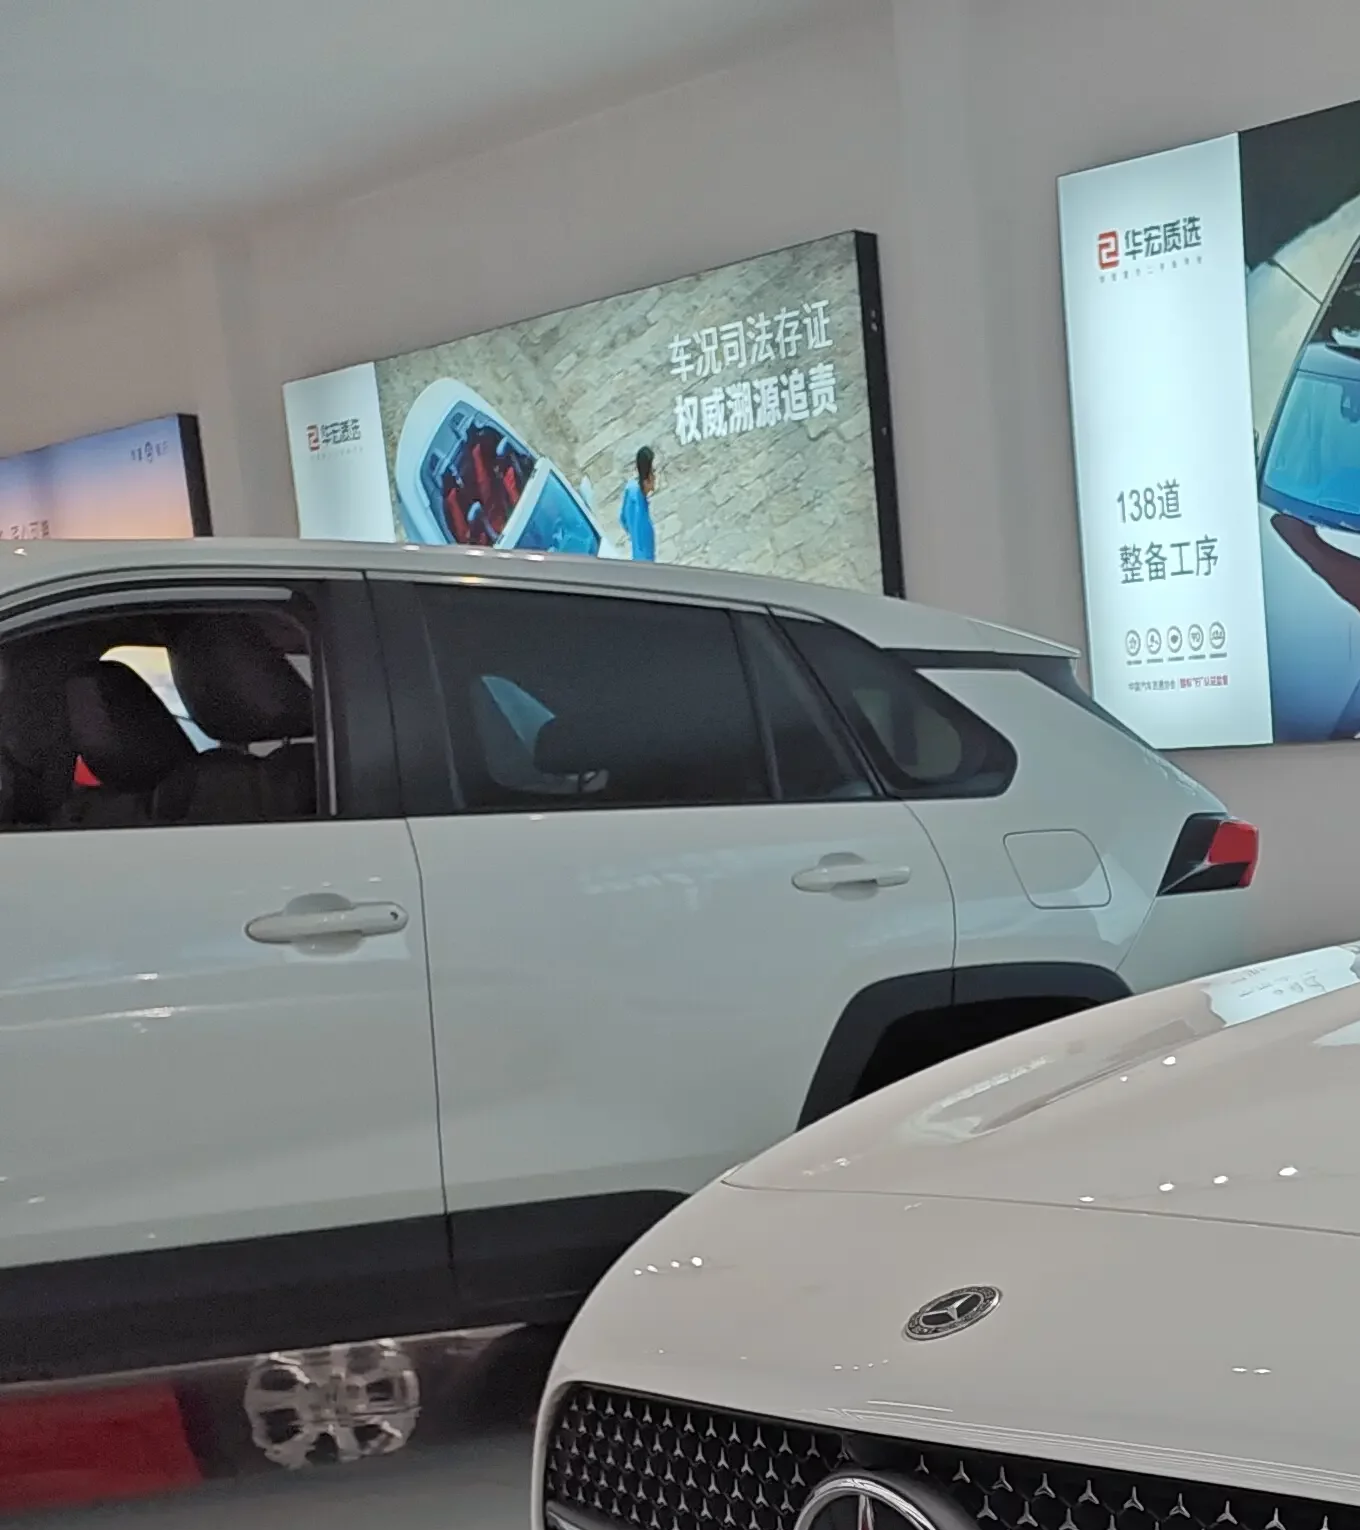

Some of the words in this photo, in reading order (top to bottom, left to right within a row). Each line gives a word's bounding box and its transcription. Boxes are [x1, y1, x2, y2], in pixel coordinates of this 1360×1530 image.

[1124, 216, 1203, 260] 华宏质选
[668, 300, 834, 382] 车况司法存证
[673, 363, 838, 445] 权威溯源追责
[1117, 479, 1182, 523] 138道
[1119, 534, 1219, 584] 整备工序
